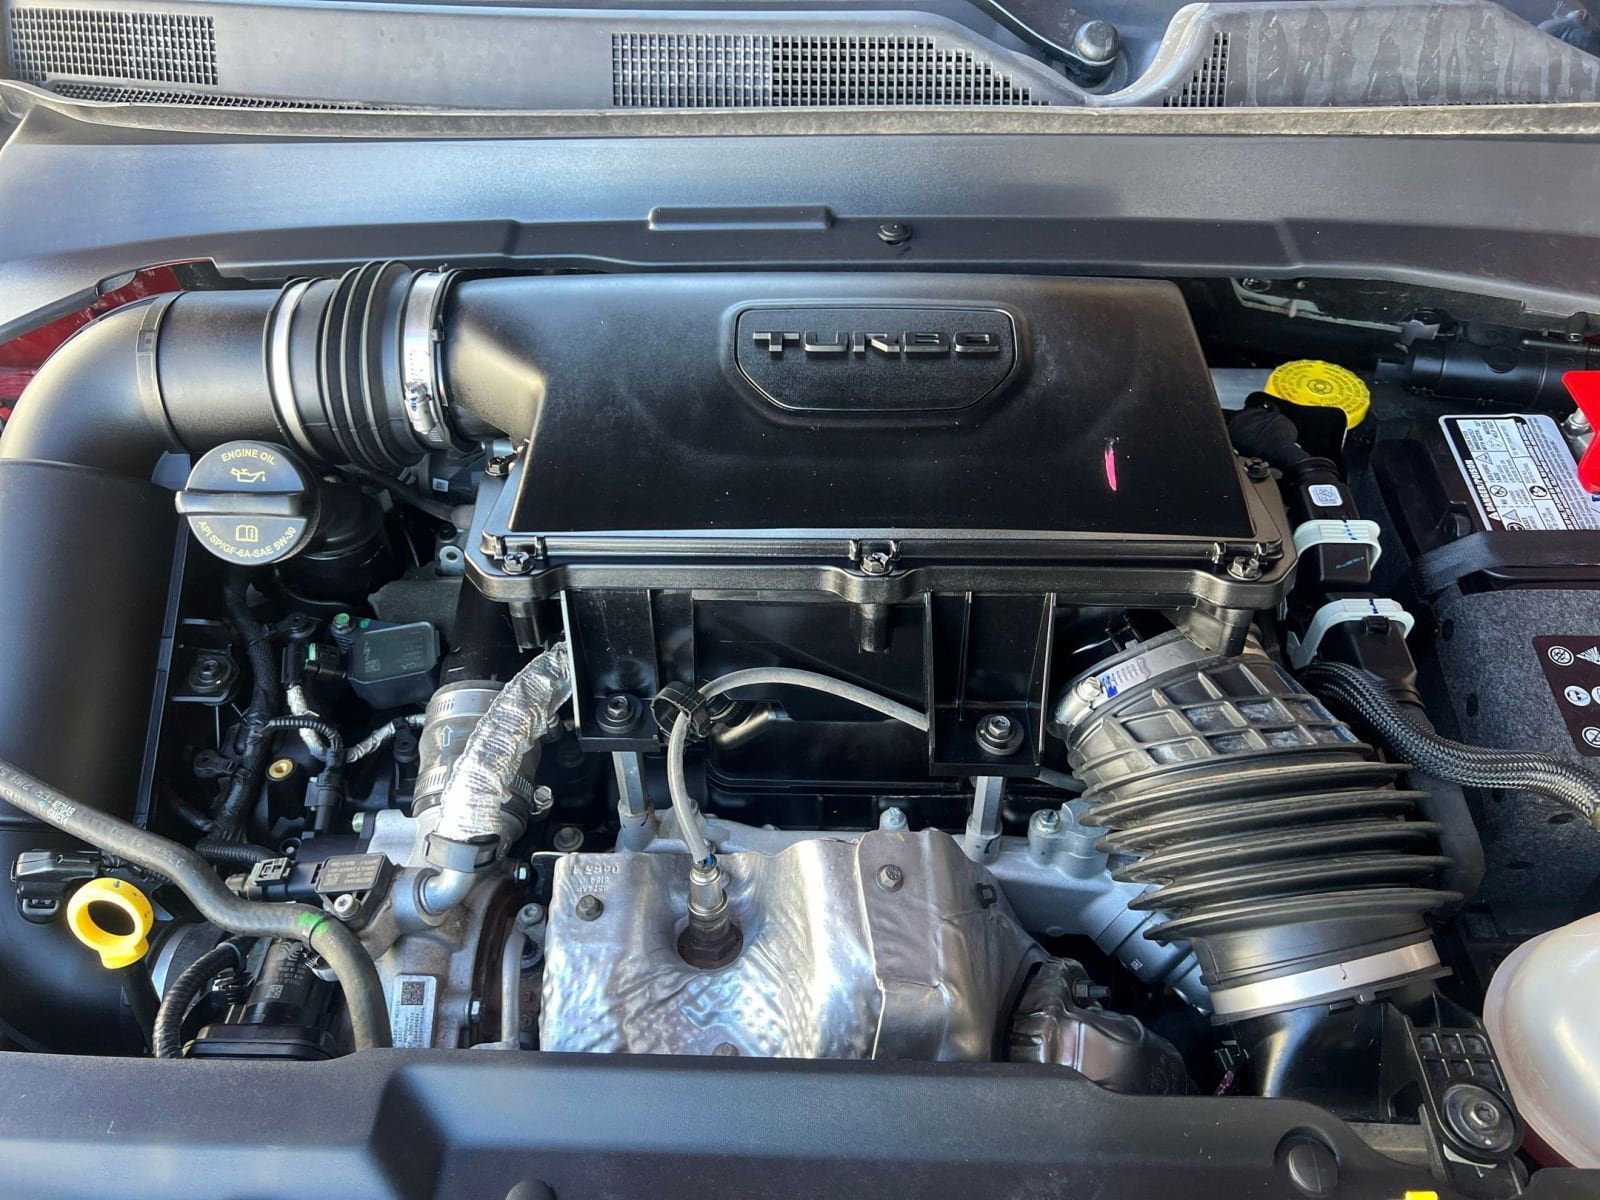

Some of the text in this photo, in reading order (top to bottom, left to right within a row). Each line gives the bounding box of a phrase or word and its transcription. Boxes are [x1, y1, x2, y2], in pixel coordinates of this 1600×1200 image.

[753, 331, 1000, 353] TURBO
[221, 448, 276, 465] ENGINE OIL
[198, 521, 213, 537] API
[273, 526, 297, 550] 5W-30
